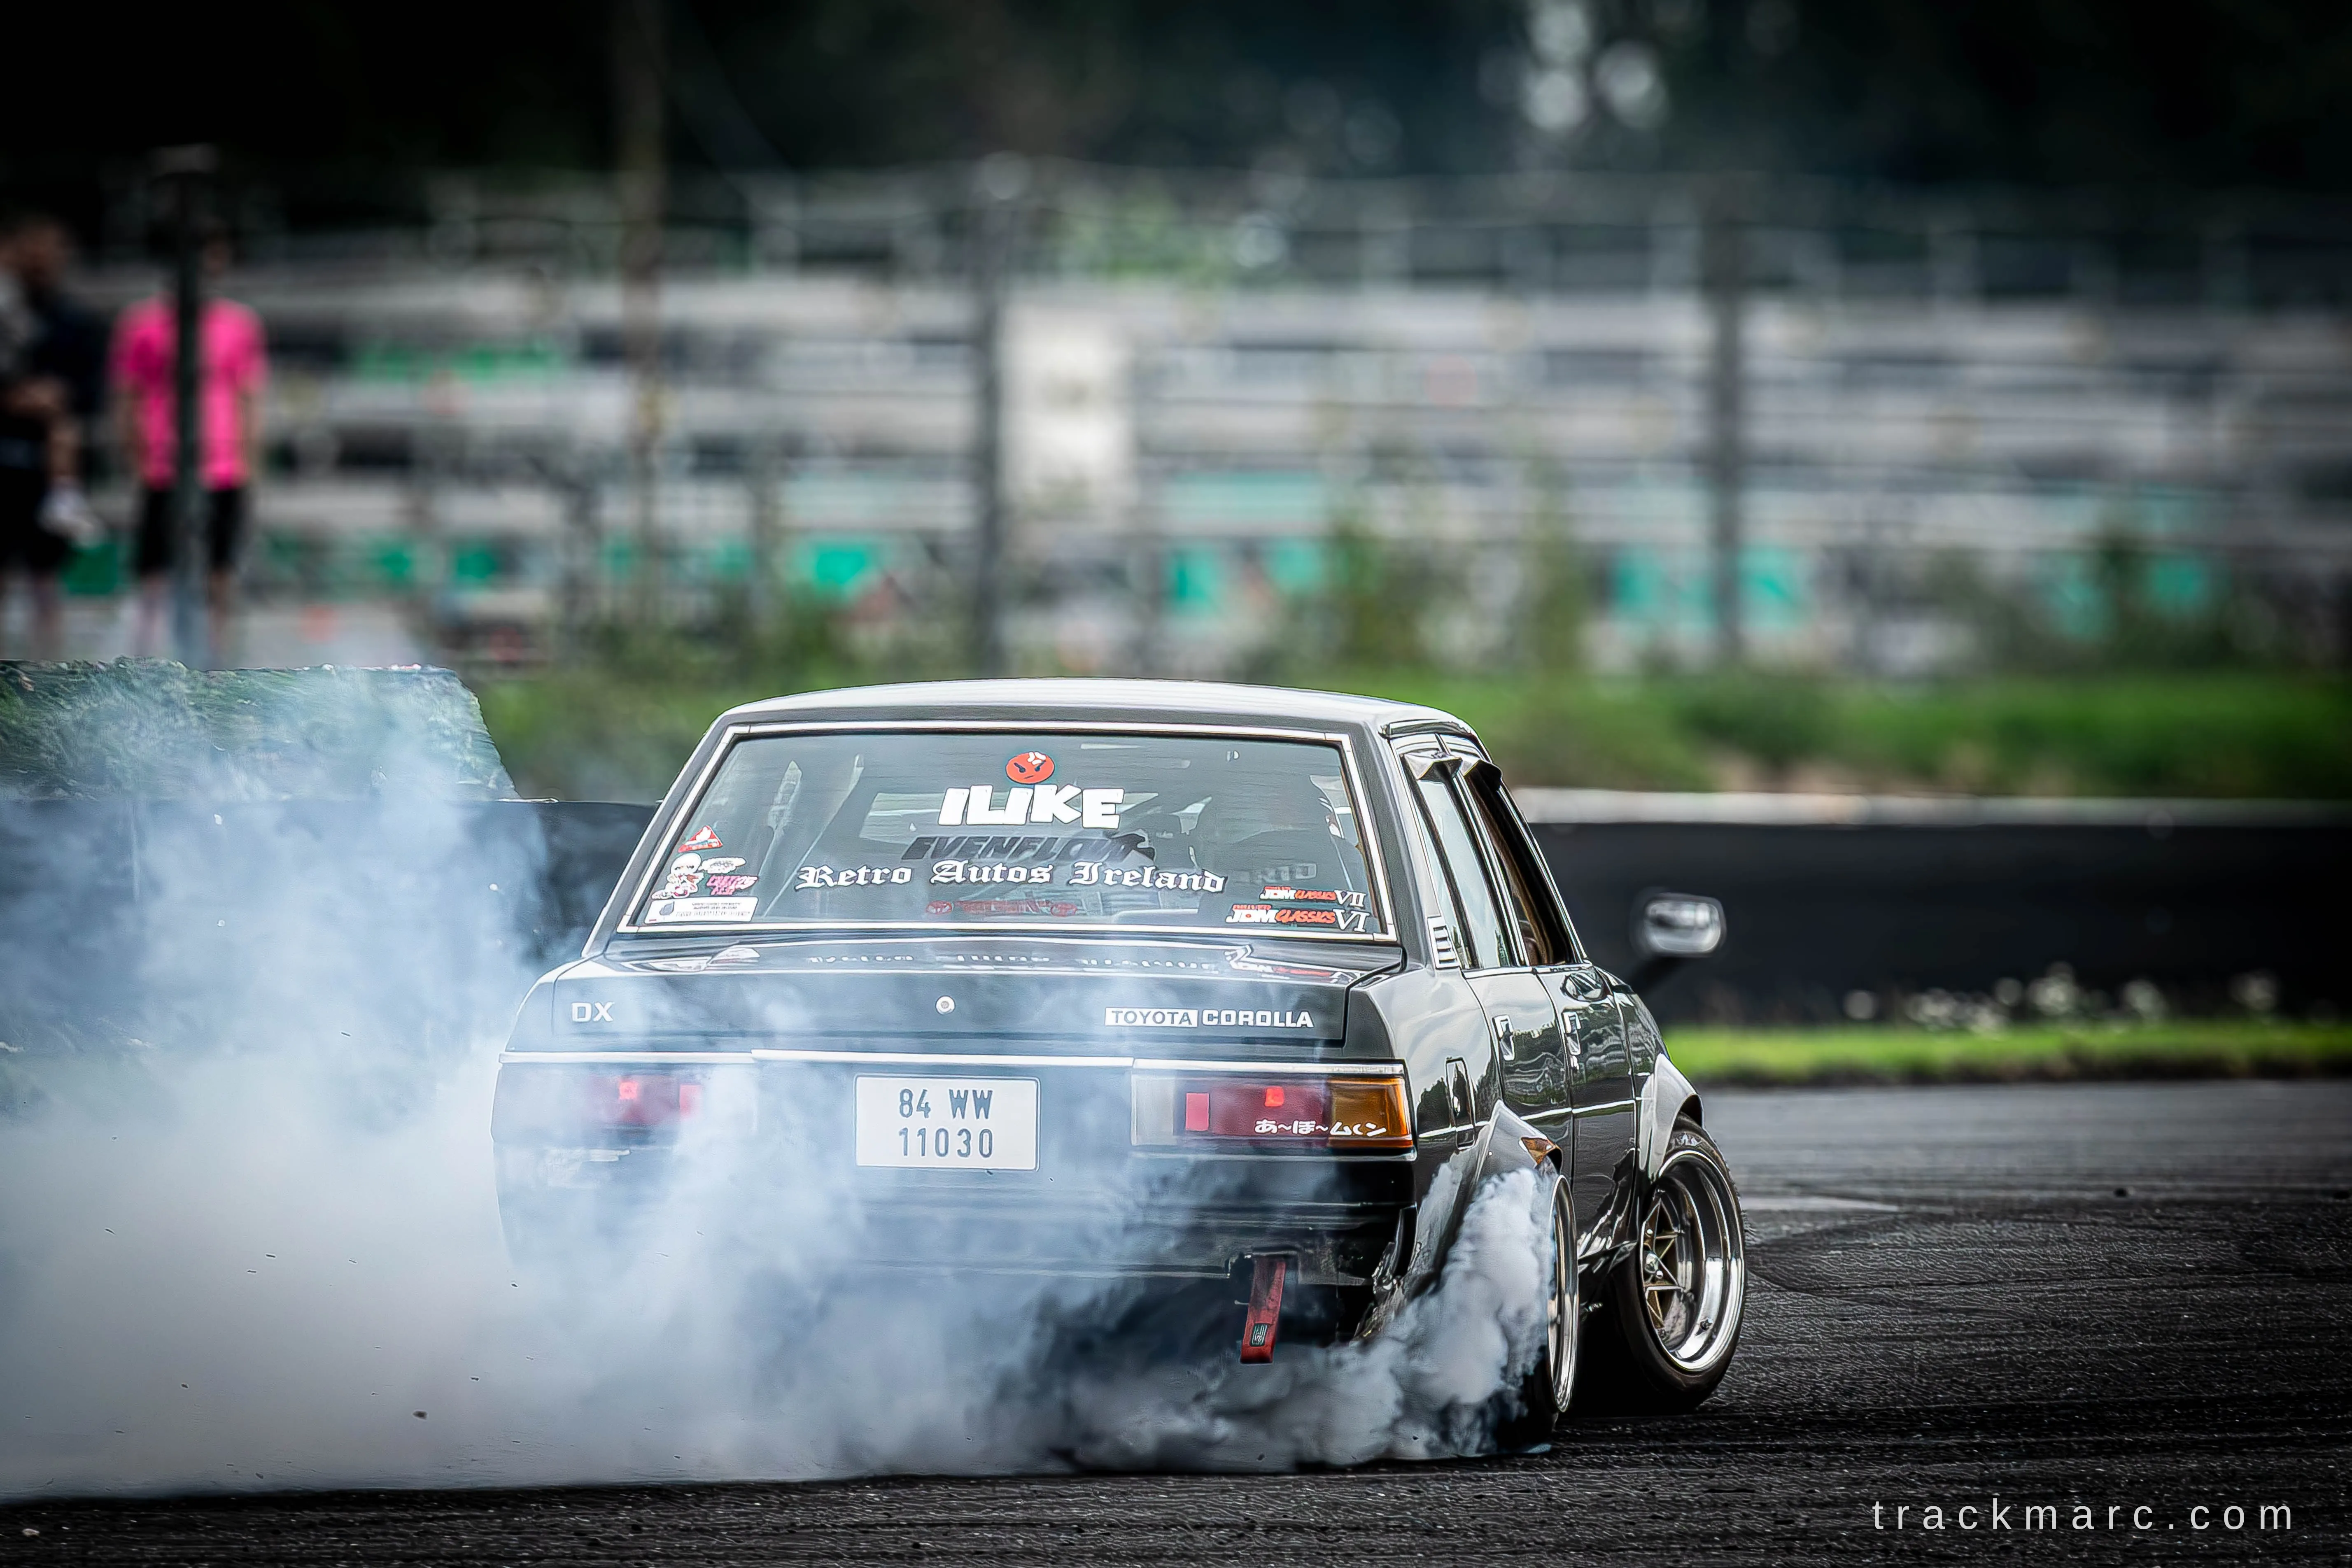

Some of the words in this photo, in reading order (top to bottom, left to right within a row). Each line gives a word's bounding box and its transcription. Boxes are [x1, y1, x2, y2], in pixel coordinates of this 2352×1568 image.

[795, 865, 912, 890] Retro
[930, 860, 1054, 884] Autos
[1069, 862, 1225, 892] Ireland
[1260, 890, 1296, 899] JDM
[1334, 890, 1366, 907] VII
[1225, 909, 1279, 923] JDM
[1275, 909, 1336, 924] CLASSICS
[1332, 909, 1370, 932] VI
[571, 1002, 615, 1023] DX
[1112, 1010, 1193, 1025] TOYOTA
[1202, 1009, 1314, 1028] COROLLA
[899, 1089, 931, 1118] 84
[949, 1089, 993, 1120] WW
[899, 1128, 993, 1158] 11030
